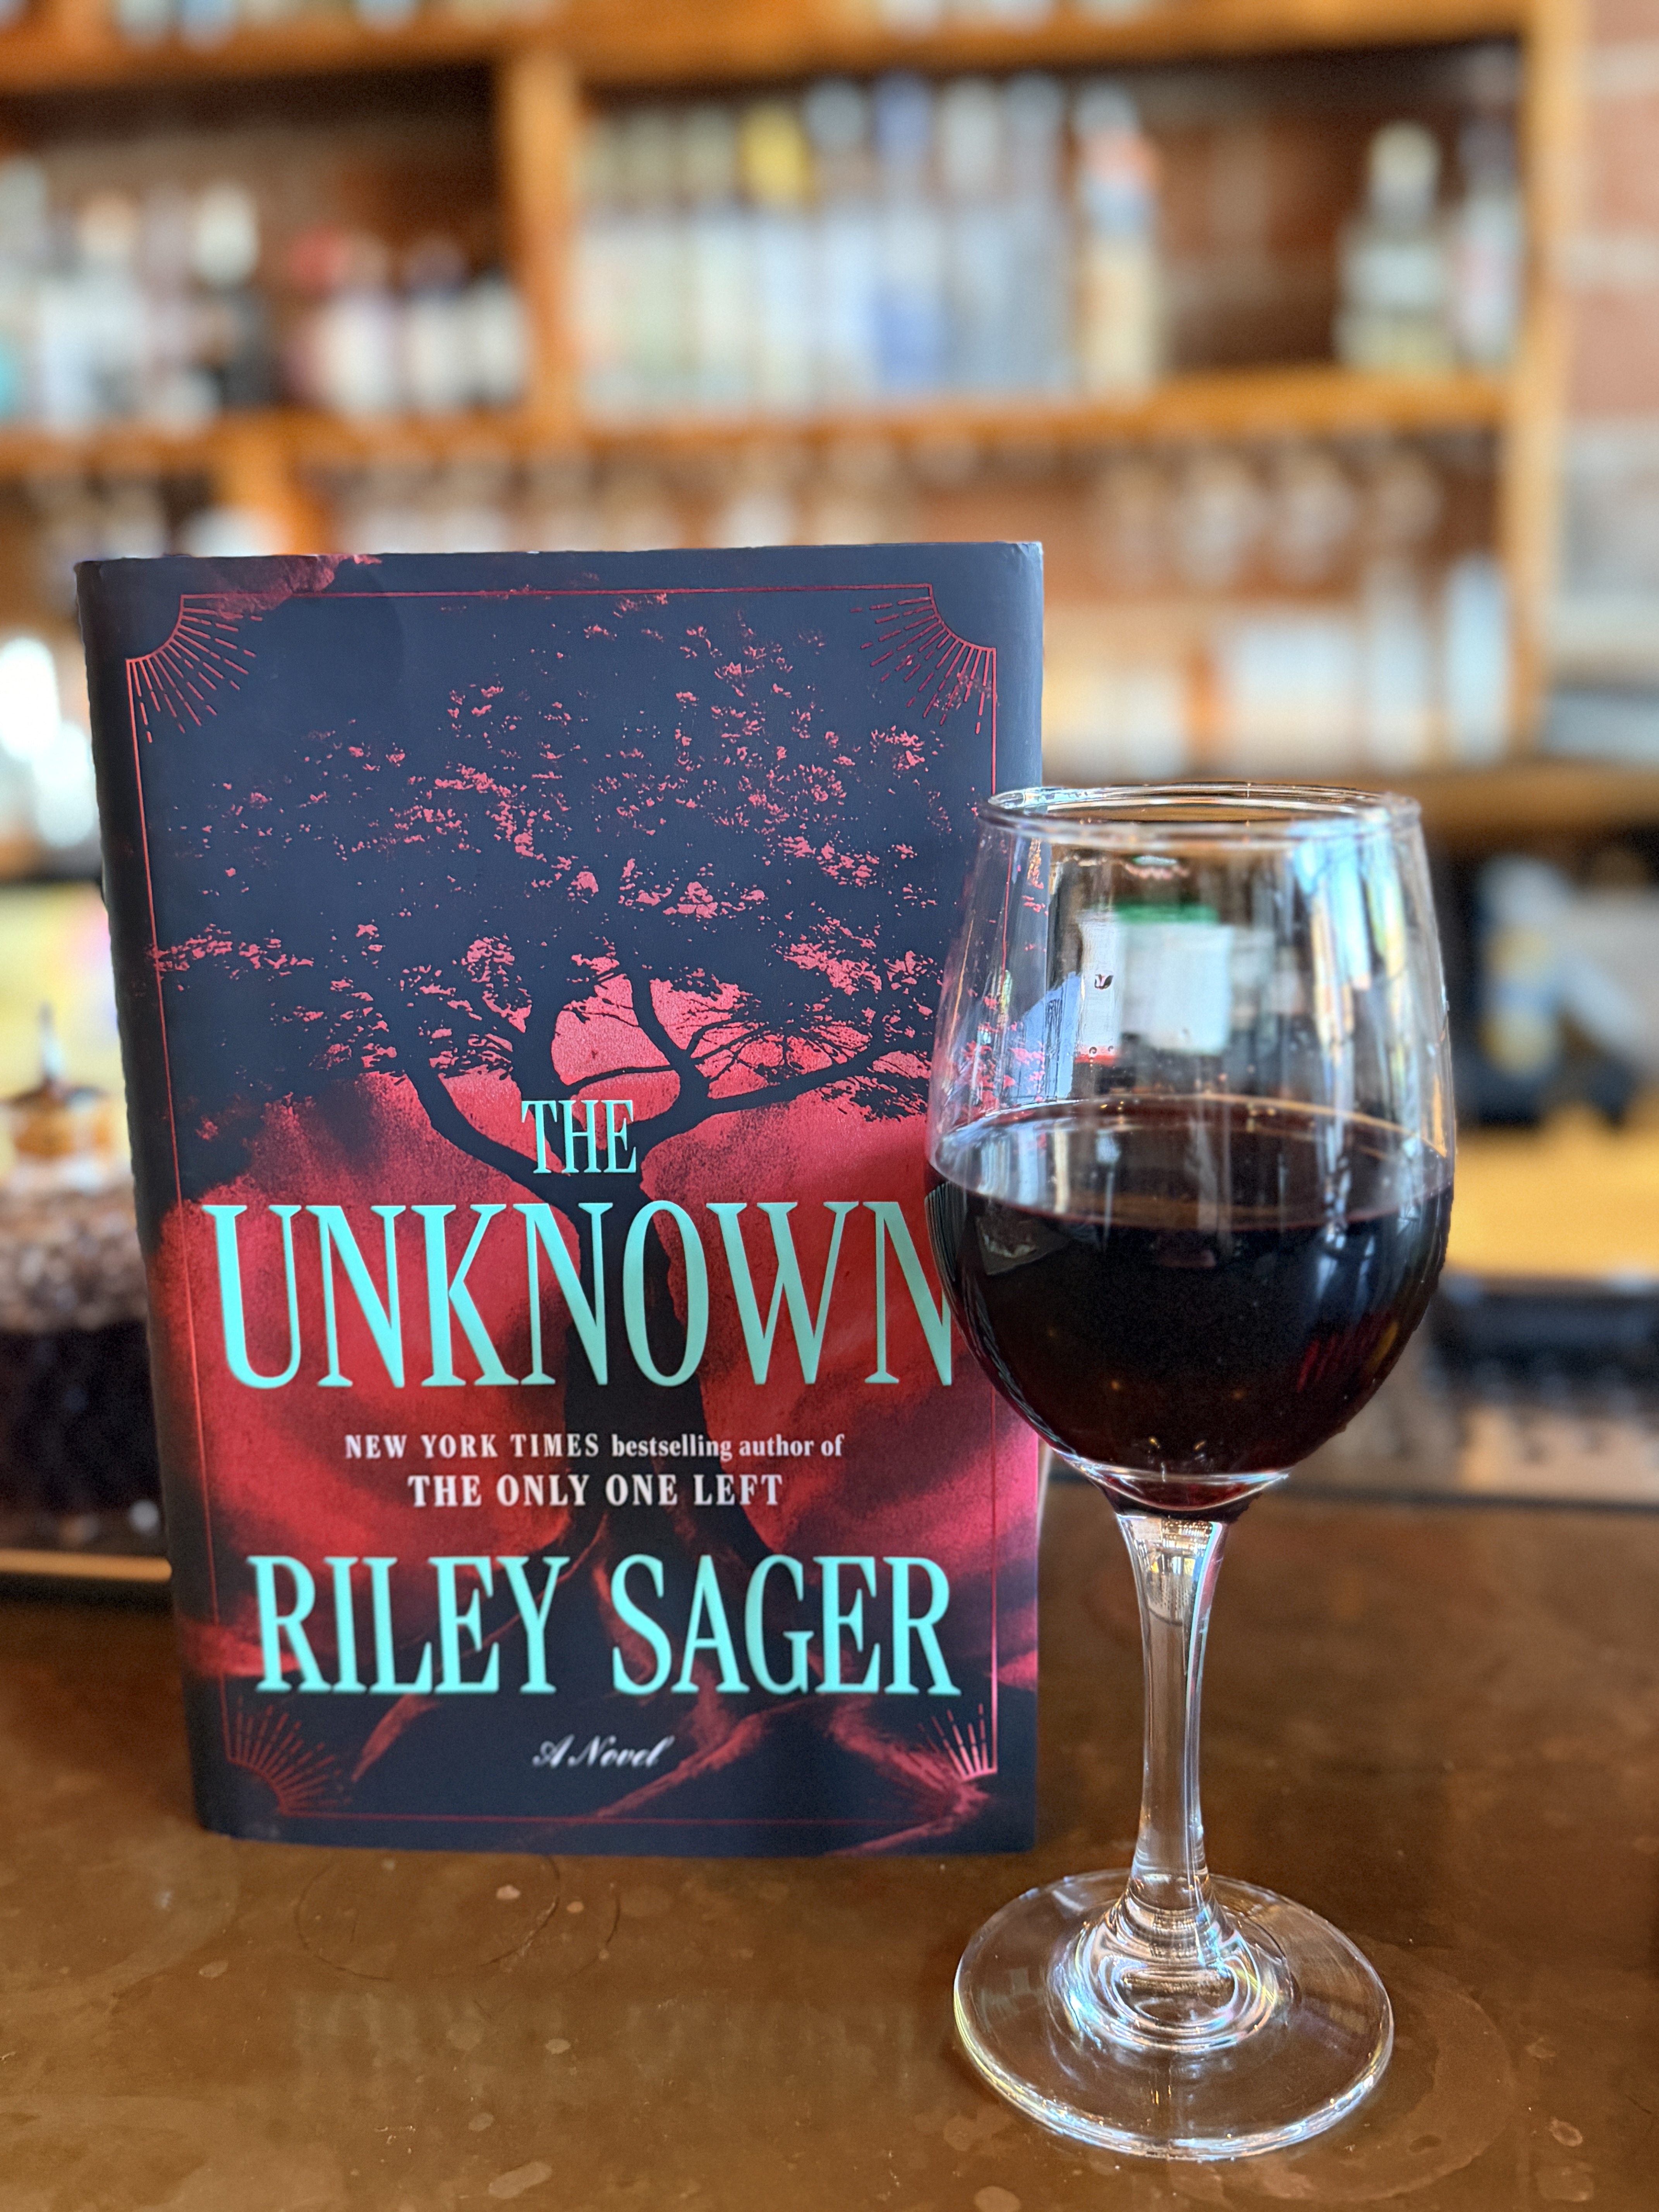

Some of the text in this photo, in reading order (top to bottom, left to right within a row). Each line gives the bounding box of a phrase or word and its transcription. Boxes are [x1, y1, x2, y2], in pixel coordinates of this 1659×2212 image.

[521, 1099, 637, 1173] THE
[201, 1200, 952, 1389] UNKNOWN
[345, 1433, 845, 1462] NEW YORK TIMES bestselling author of
[407, 1474, 783, 1507] THE ONLY ONE LEFT
[247, 1554, 961, 1695] RILEY SAGER
[533, 1735, 674, 1767] A Novel
